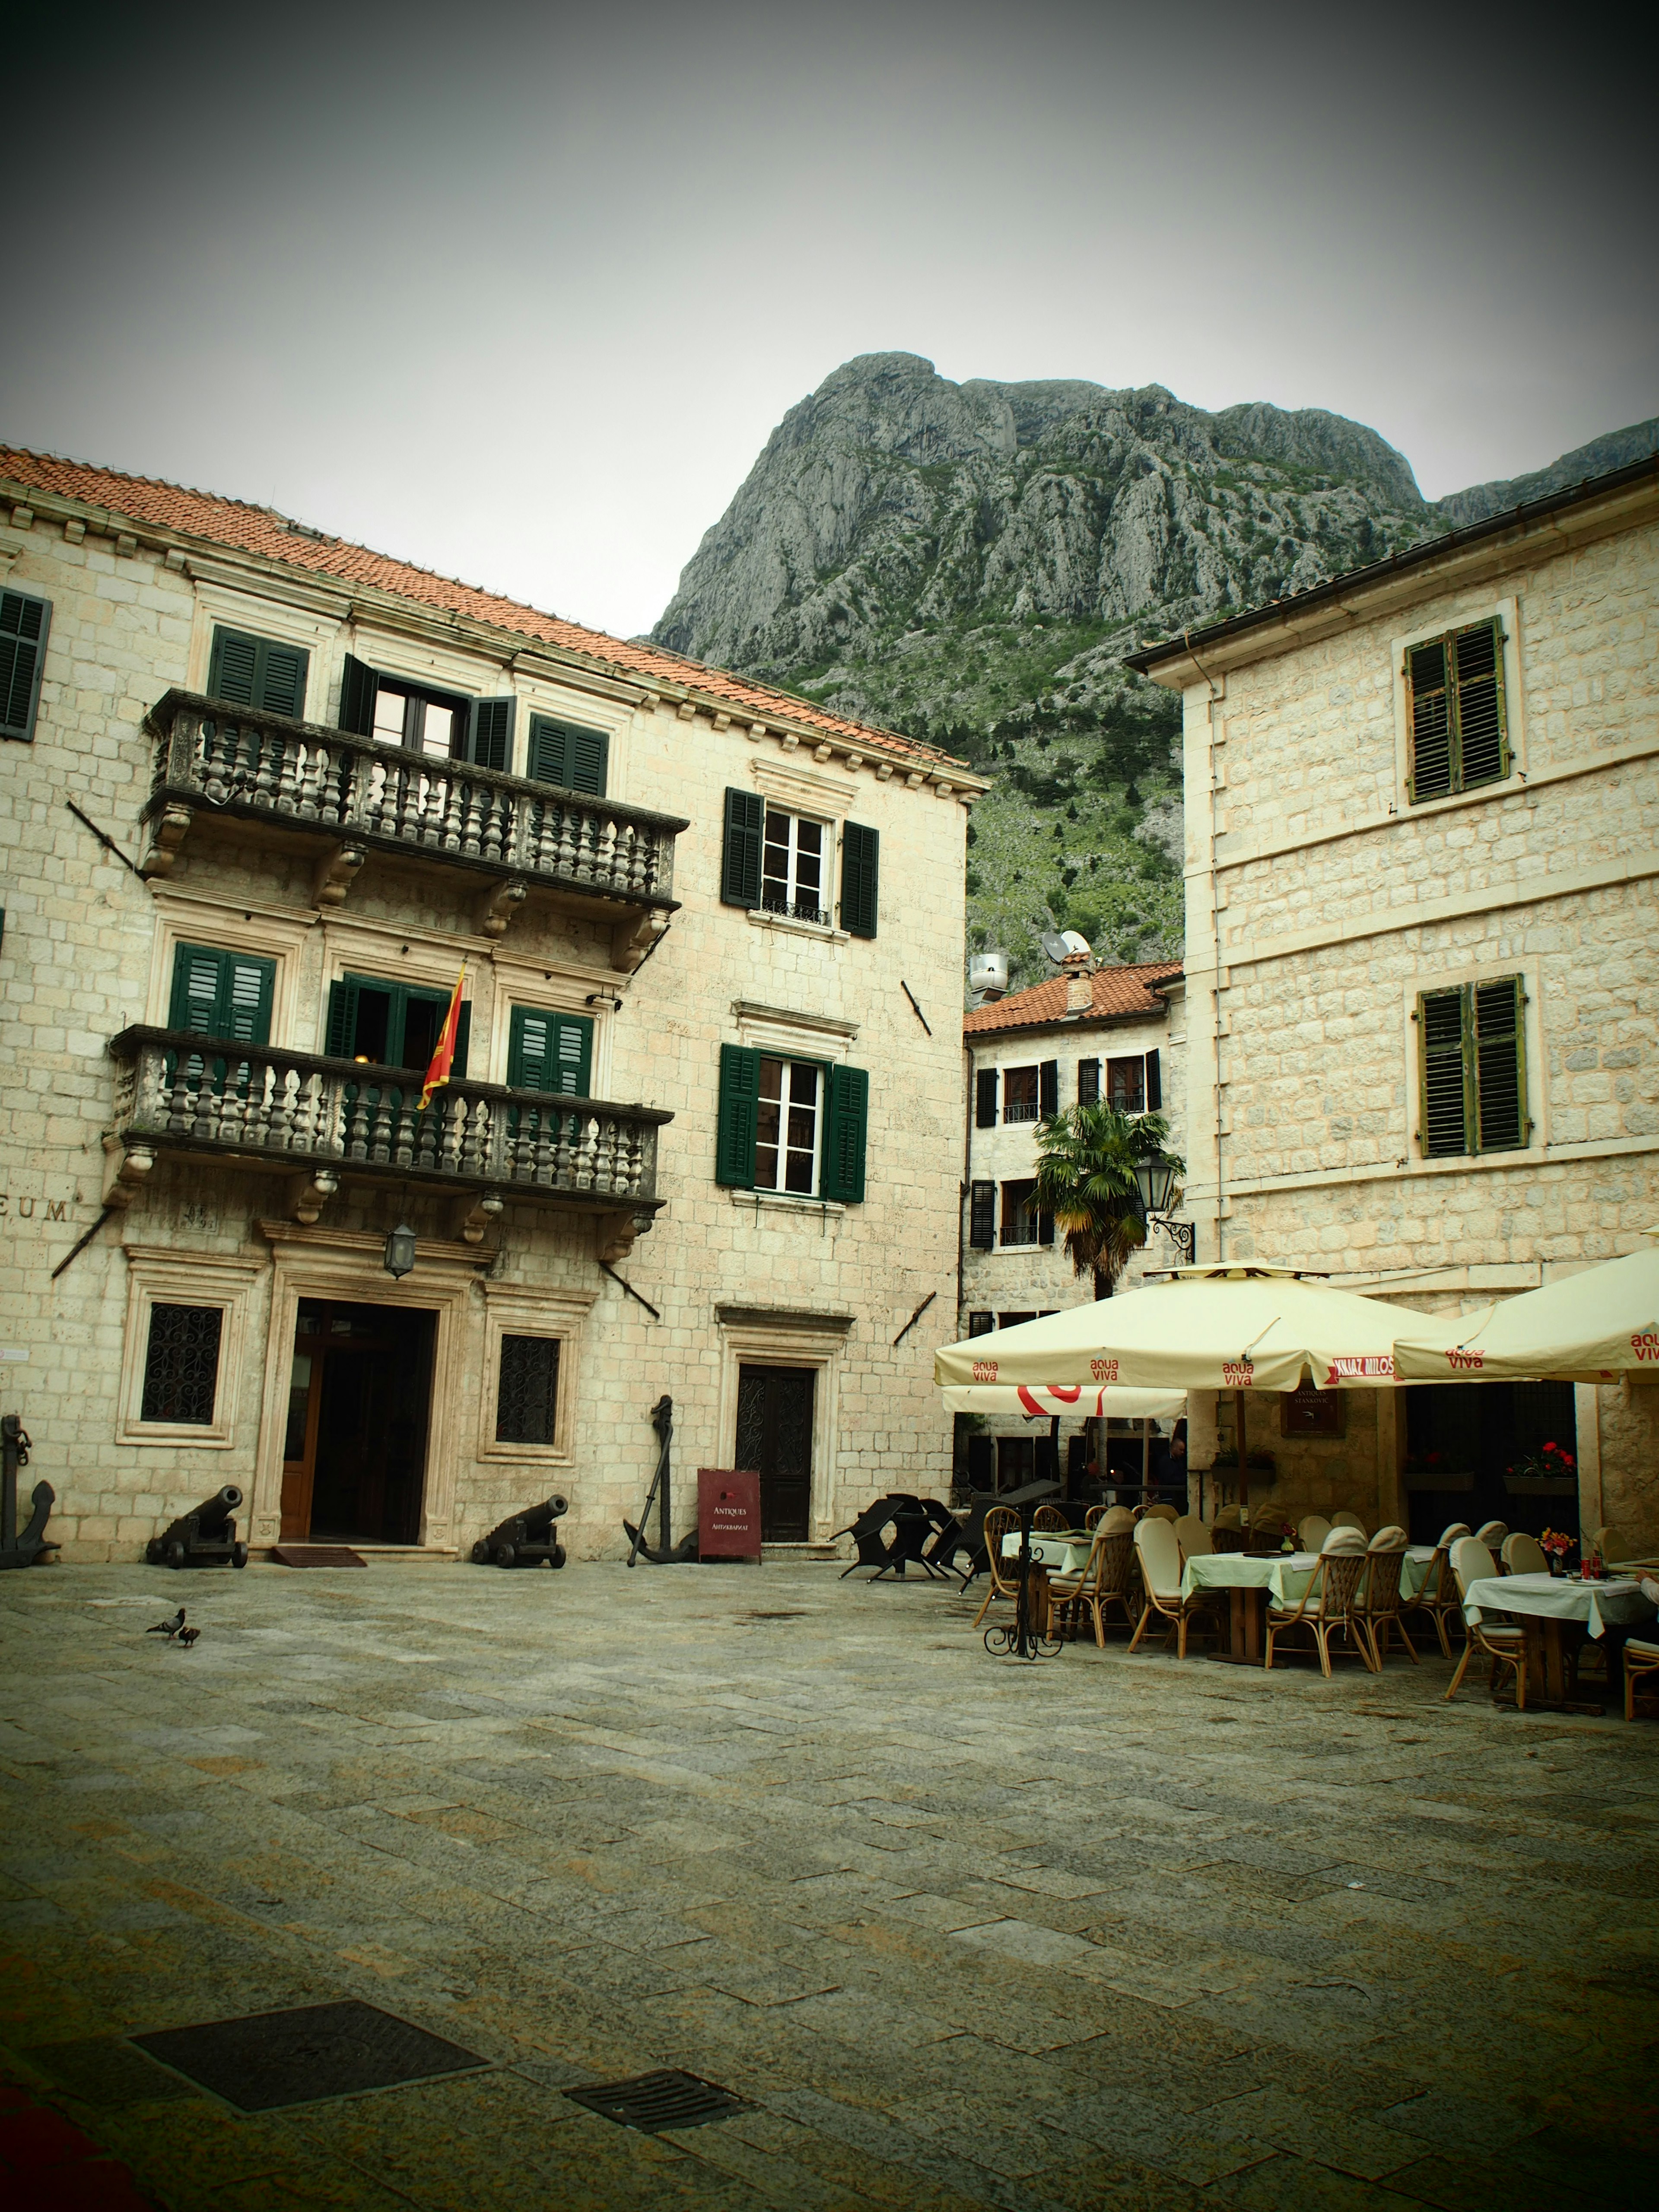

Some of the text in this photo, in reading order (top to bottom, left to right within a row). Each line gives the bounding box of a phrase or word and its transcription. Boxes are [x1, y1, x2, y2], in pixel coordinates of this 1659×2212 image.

[972, 1362, 998, 1371] aqua
[1090, 1359, 1119, 1370] aqua
[1222, 1363, 1254, 1374] aqua
[1334, 1358, 1363, 1376] KNJAZ
[714, 1507, 747, 1516] ANTIQUES
